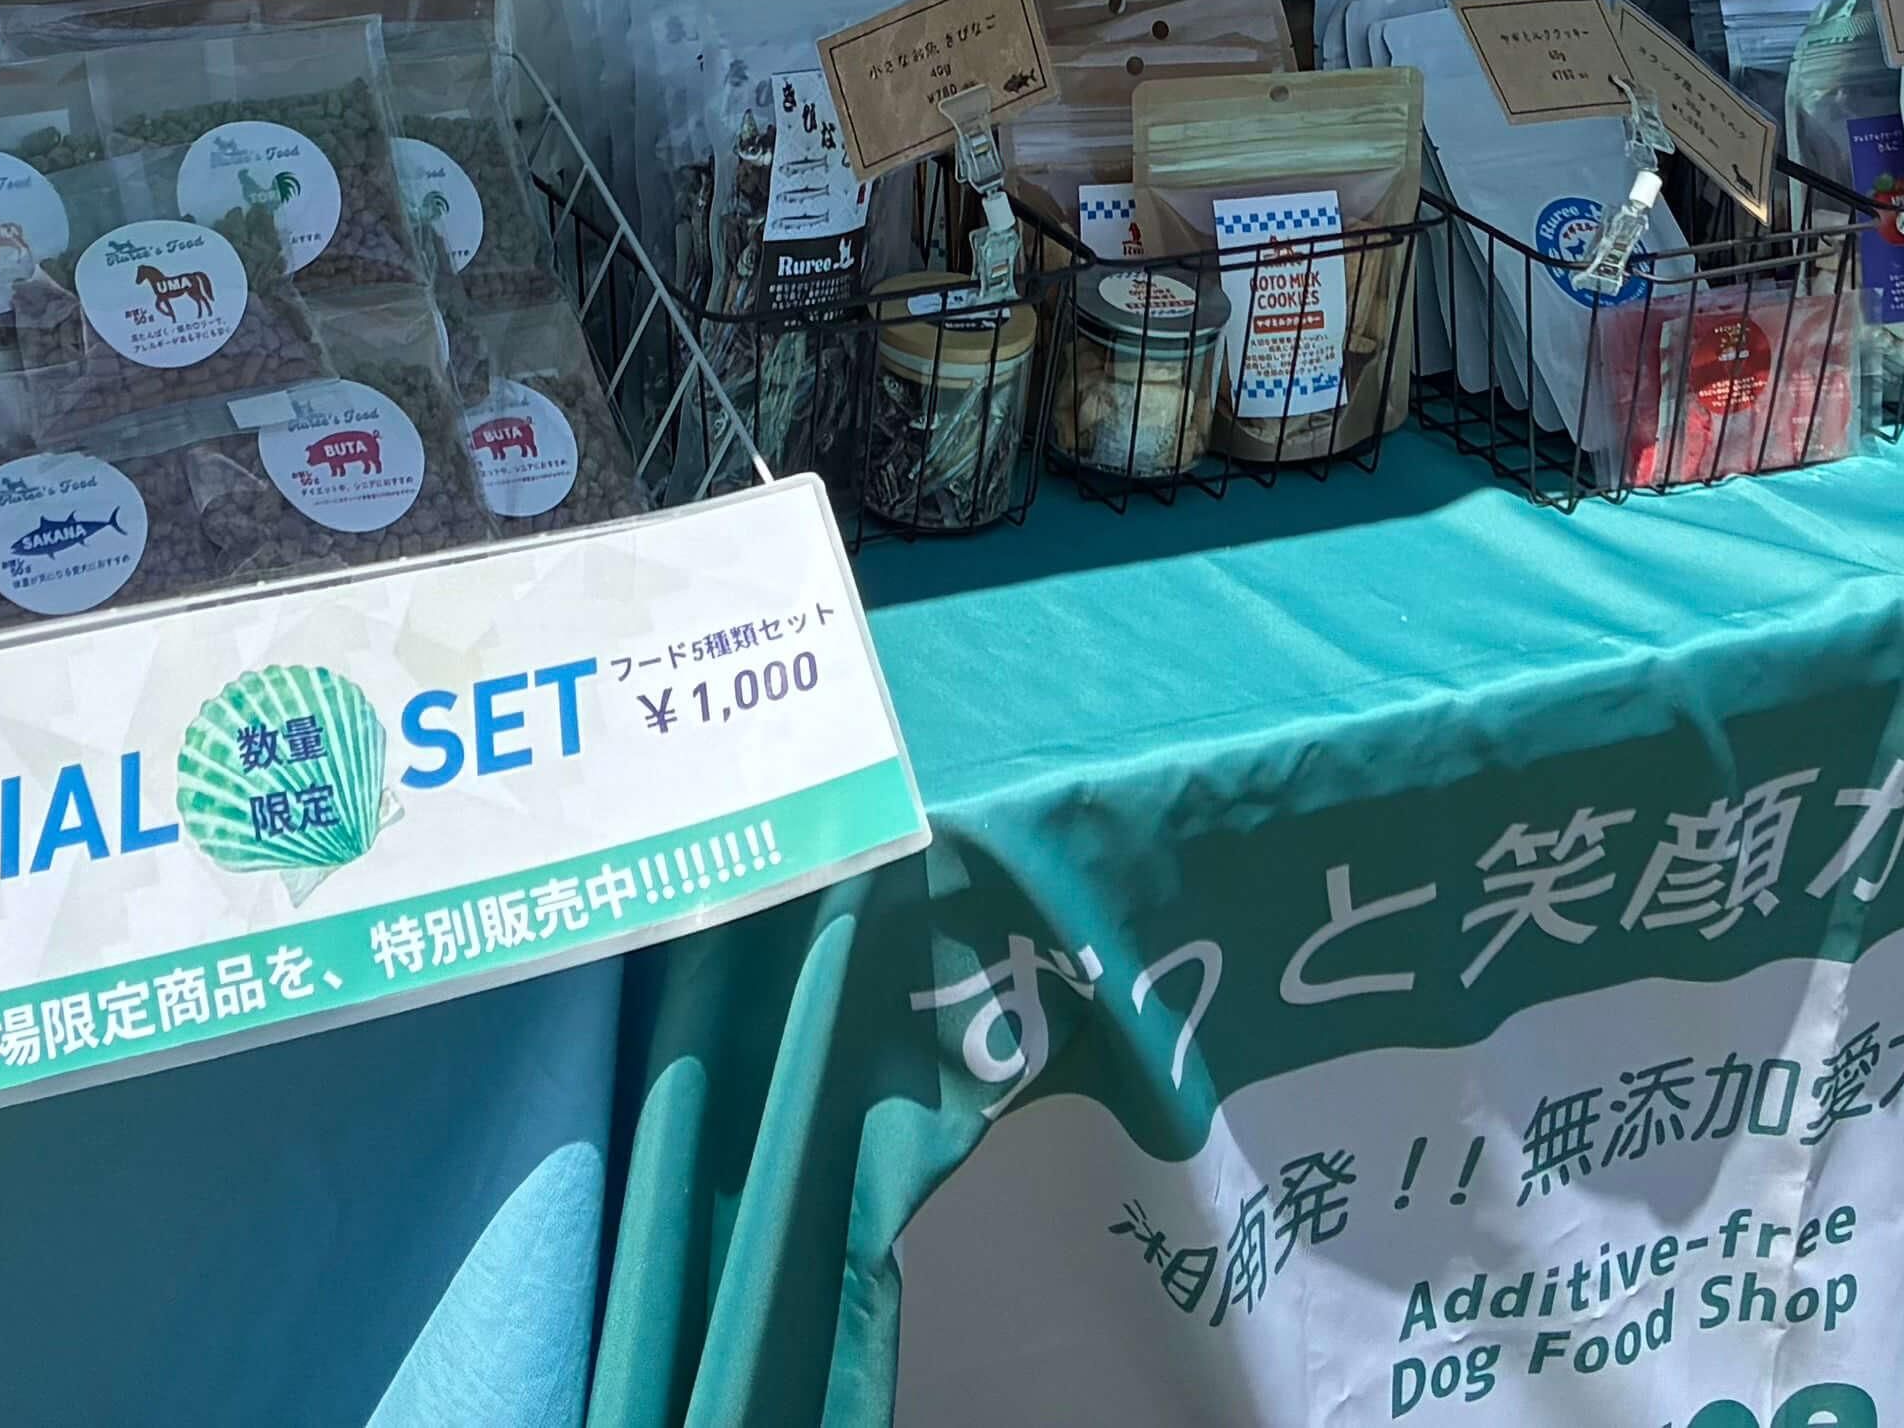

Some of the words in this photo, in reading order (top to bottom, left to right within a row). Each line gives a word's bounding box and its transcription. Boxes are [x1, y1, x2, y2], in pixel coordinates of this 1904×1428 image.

[156, 277, 193, 295] UMA
[778, 255, 832, 277] Ruree
[324, 441, 368, 459] BUTA
[483, 426, 522, 443] BUTA
[22, 522, 87, 549] SAKANA
[611, 600, 837, 685] フード5種類セット
[400, 656, 597, 789] SET
[635, 648, 820, 739] ¥1,000
[236, 715, 327, 775] 数量
[249, 781, 341, 843] 限定
[1400, 1201, 1857, 1341] Additive-free
[1391, 1341, 1501, 1420] Dog
[1528, 1284, 1675, 1377] Food
[1698, 1265, 1859, 1334] Shop
